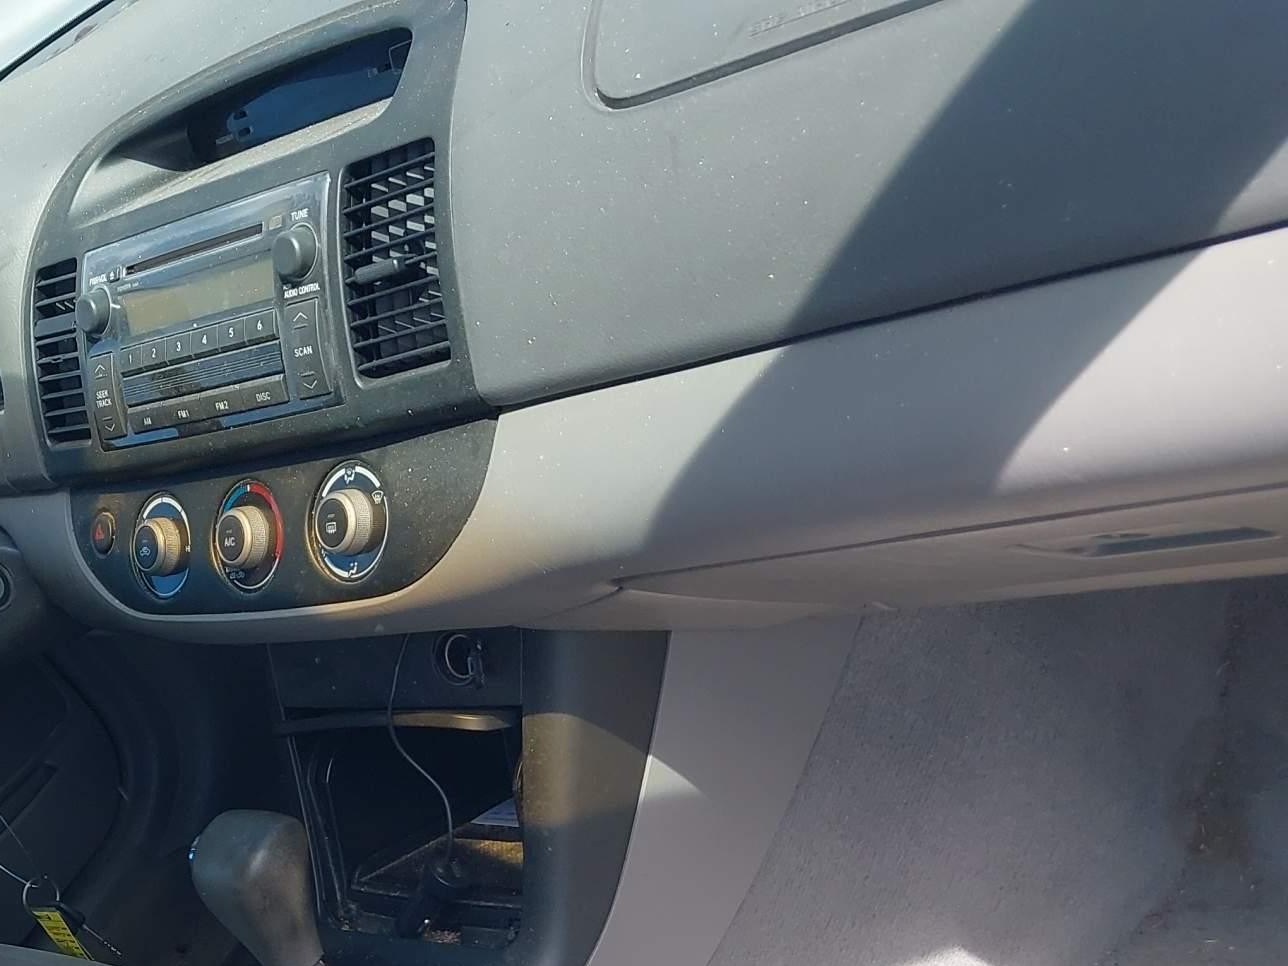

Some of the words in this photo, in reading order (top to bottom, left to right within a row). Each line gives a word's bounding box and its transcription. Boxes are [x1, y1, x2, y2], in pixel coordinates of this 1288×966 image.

[291, 208, 309, 221] TUNE
[128, 354, 132, 364] 1
[151, 347, 156, 358] 2
[176, 341, 182, 352] 3
[201, 334, 207, 345] 4
[228, 327, 234, 337] 5
[256, 320, 263, 331] 6
[294, 345, 313, 358] SCAN
[96, 389, 109, 400] SEEK
[96, 398, 112, 409] TRACK
[177, 409, 190, 419] FM1
[215, 400, 229, 411] FM2
[255, 391, 271, 402] DISC
[224, 537, 236, 548] A/C
